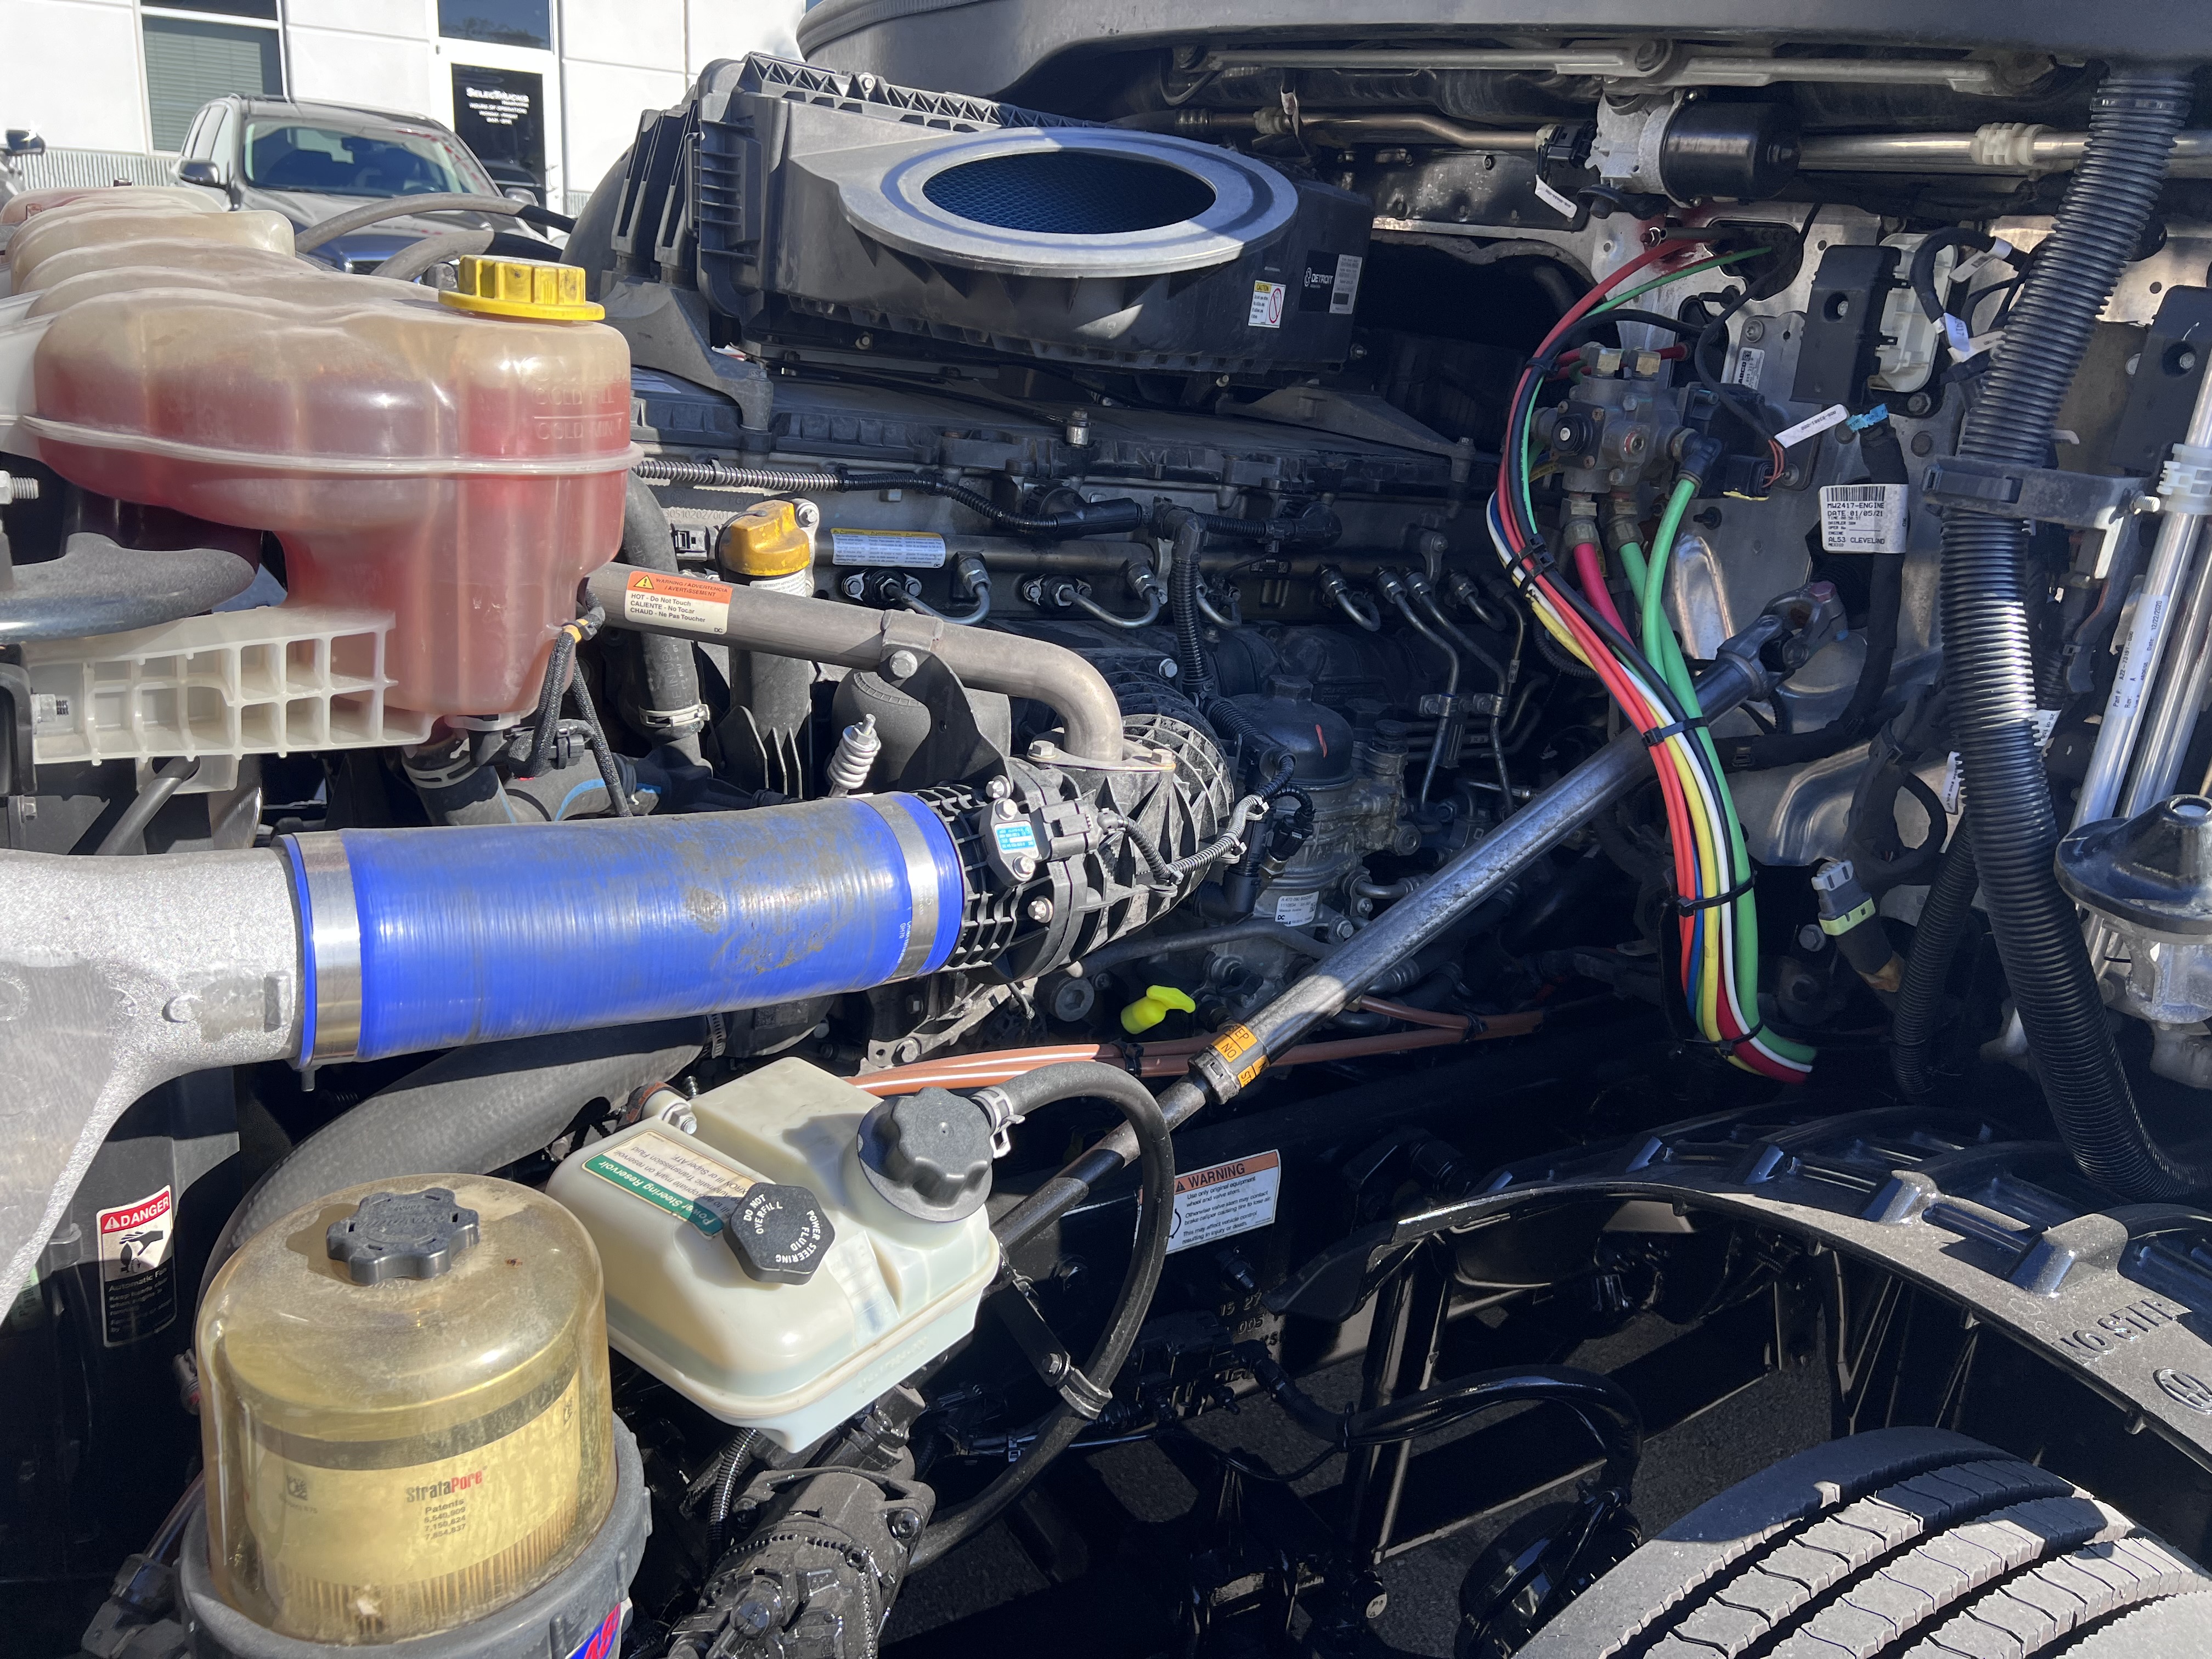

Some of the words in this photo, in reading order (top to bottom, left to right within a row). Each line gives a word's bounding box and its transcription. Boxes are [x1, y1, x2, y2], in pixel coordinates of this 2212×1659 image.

[1311, 274, 1333, 284] DETROIT
[1738, 362, 1747, 384] ABCO
[533, 387, 583, 405] COLD
[536, 422, 584, 439] COLD
[1902, 517, 1907, 527] OK
[668, 586, 716, 597] AVERTISSEMENT
[687, 583, 728, 592] ADVERTENCIA
[630, 600, 662, 610] CALIENTE
[673, 599, 691, 607] Touch
[681, 614, 706, 623] Toucher
[2151, 601, 2163, 630] 12/22/2020
[667, 674, 679, 687] IN
[672, 690, 684, 708] DE
[899, 923, 907, 939] GH70
[1221, 1043, 1237, 1058] NO
[631, 1146, 648, 1159] Fluid
[599, 1161, 643, 1187] Reservoir
[649, 1155, 695, 1183] Transmission
[654, 1171, 674, 1185] mark
[685, 1160, 709, 1176] Super
[1188, 1163, 1245, 1188] WARNING
[642, 1184, 681, 1209] Steering
[673, 1181, 713, 1206] appropriate
[695, 1178, 730, 1199] Automatic
[1198, 1189, 1209, 1198] only
[1210, 1183, 1229, 1194] original
[1230, 1176, 1256, 1188] equipment
[120, 1196, 169, 1227] DANGER
[743, 1209, 753, 1222] DO
[749, 1194, 766, 1209] NOT
[1185, 1207, 1211, 1218] Otherwise
[1212, 1202, 1225, 1210] valve
[1239, 1195, 1250, 1204] may
[1250, 1190, 1268, 1200] contact
[1186, 1199, 1201, 1207] wheel
[682, 1204, 714, 1226] Power
[754, 1201, 783, 1234] OVERFILL
[806, 1210, 821, 1240] POWER
[1184, 1216, 1199, 1226] brake
[1199, 1212, 1217, 1222] caliper
[1217, 1206, 1237, 1216] causing
[1194, 1227, 1206, 1235] may
[1206, 1221, 1221, 1231] affect
[1222, 1216, 1239, 1226] vehicle
[1240, 1210, 1257, 1220] control
[790, 1227, 810, 1251] FLUID
[1182, 1234, 1204, 1244] resulting
[1211, 1227, 1226, 1237] injury
[1232, 1221, 1248, 1229] death.
[775, 1243, 817, 1263] STEERING
[2097, 1298, 2177, 1342] STEP
[406, 1470, 483, 1503] StrataPore
[425, 1499, 465, 1514] Patents
